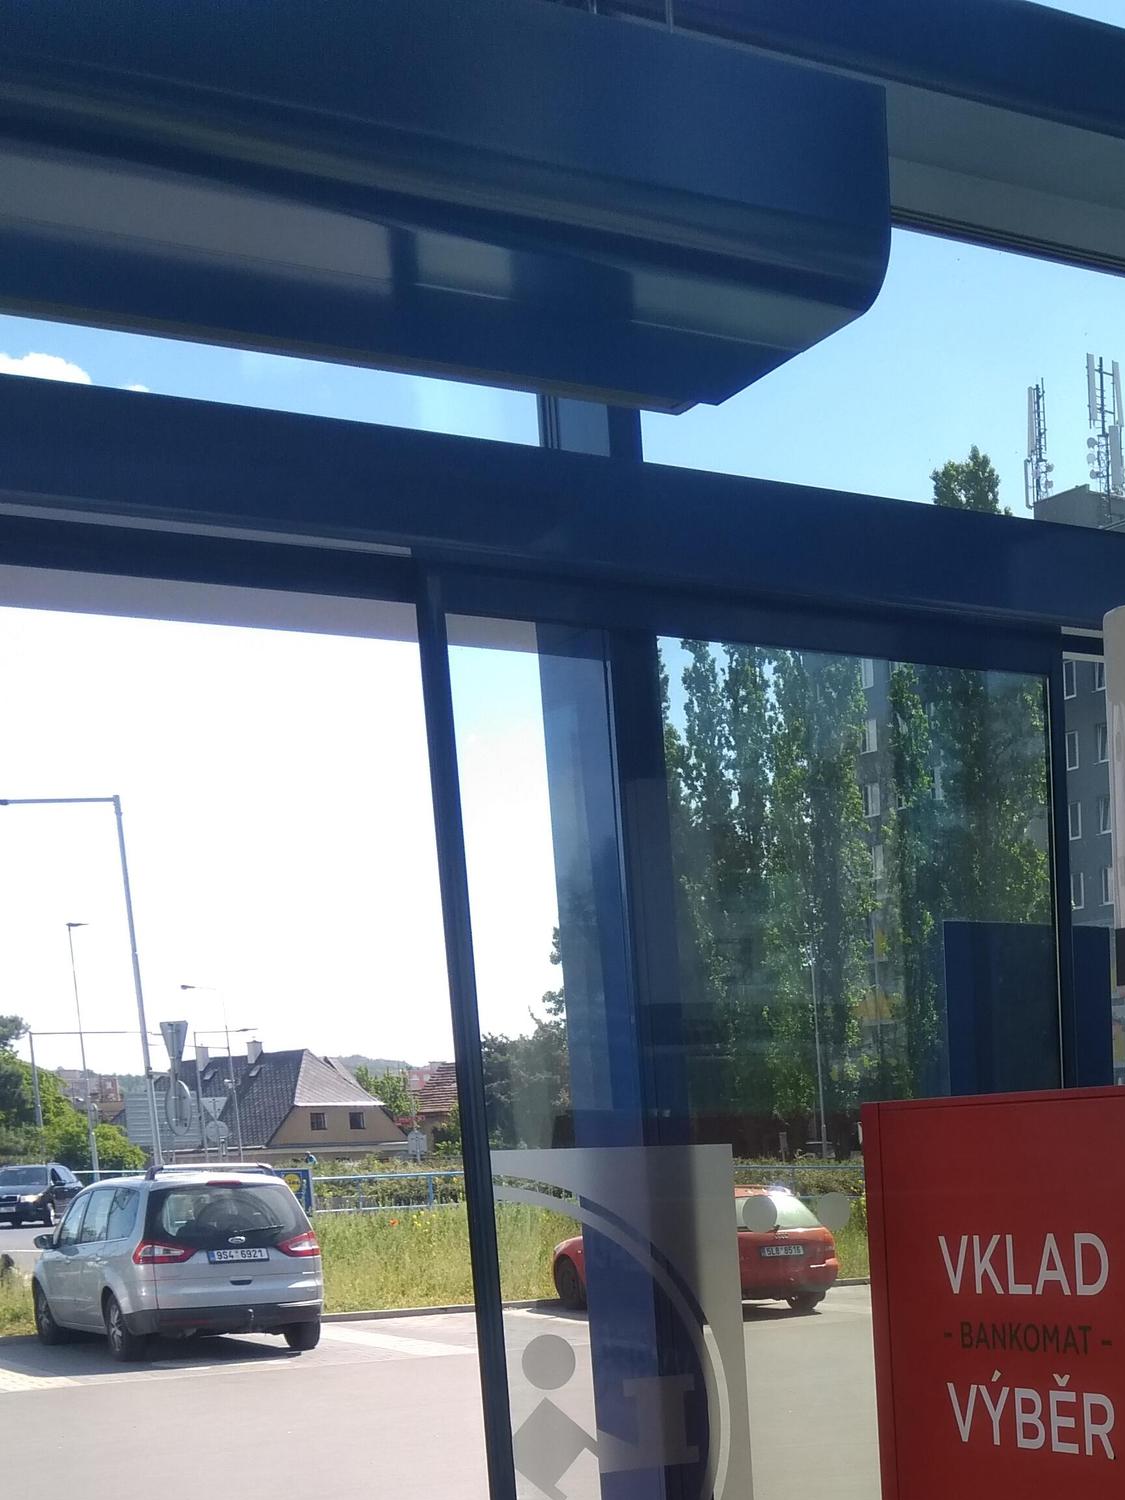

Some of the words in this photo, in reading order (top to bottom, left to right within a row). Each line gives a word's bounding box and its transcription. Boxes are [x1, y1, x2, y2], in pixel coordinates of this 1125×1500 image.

[216, 1250, 234, 1260] 9S4
[240, 1249, 264, 1259] 6921
[938, 1232, 1109, 1296] VKLAD
[960, 1321, 1092, 1355] BANKOMAT
[946, 1369, 1116, 1461] VÝBĚR
